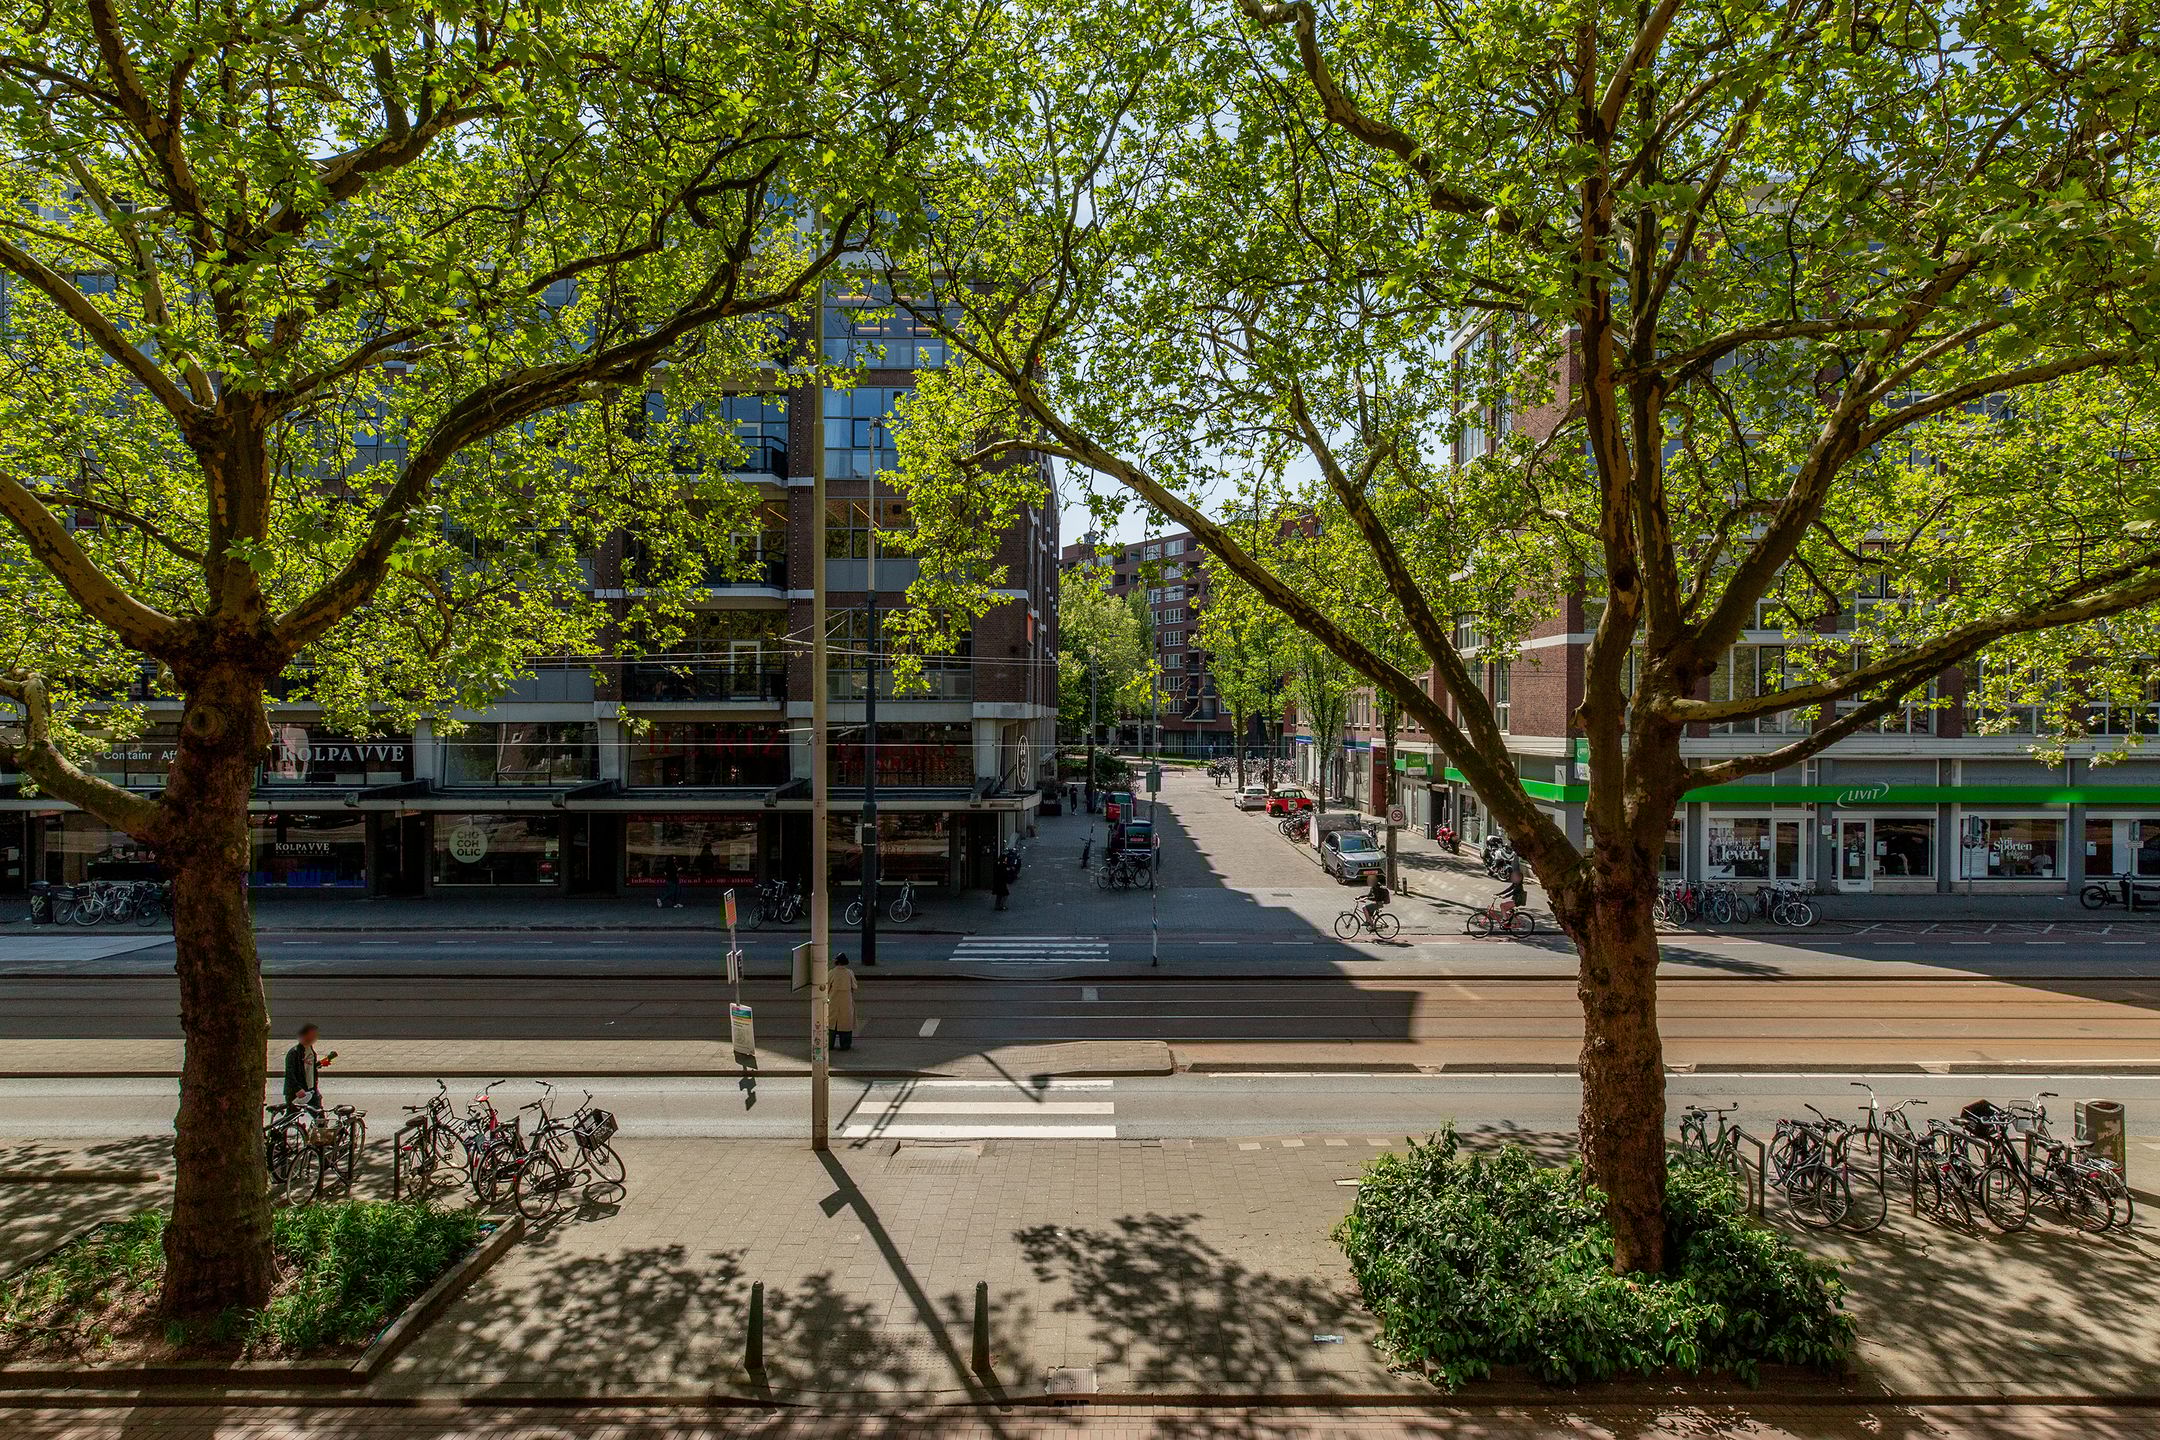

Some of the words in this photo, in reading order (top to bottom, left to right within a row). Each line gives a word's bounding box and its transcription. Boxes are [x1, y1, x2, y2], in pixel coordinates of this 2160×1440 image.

[1848, 788, 1880, 801] LIVIT
[457, 831, 480, 840] CHO
[456, 840, 480, 848] COH
[1993, 840, 2033, 854] Sporten
[457, 849, 481, 857] OLIC
[1720, 845, 1764, 861] leven.
